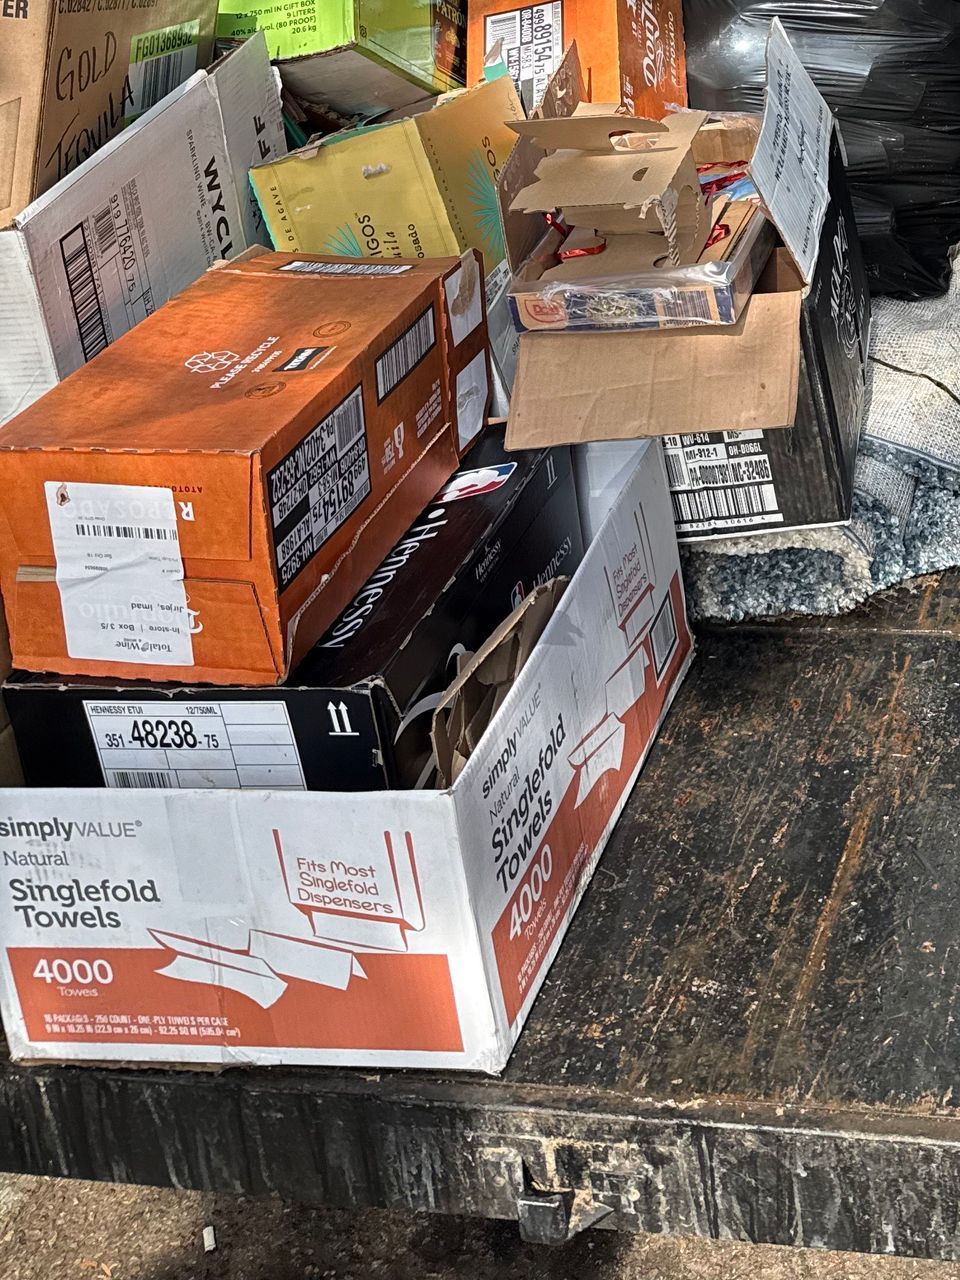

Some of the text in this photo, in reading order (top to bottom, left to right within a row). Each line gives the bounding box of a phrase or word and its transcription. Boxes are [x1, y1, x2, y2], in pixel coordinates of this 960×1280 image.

[284, 2, 299, 10] GIFT
[300, 0, 316, 8] BOX
[293, 8, 316, 17] LITERS
[289, 16, 316, 26] PROOF)
[308, 24, 317, 32] kg
[534, 8, 552, 75] 499 89154 75
[667, 10, 678, 87] REPOSADO
[56, 31, 117, 101] GOLD
[642, 24, 661, 93] Don
[45, 73, 135, 181] TEQUILA
[185, 129, 207, 209] SPARKLING WINE
[111, 194, 122, 220] 919
[269, 185, 295, 242] DE AGAVE
[115, 218, 136, 271] 776420
[357, 213, 383, 258] IGOS
[209, 362, 247, 389] PLEASE
[243, 336, 280, 364] RECYCLE
[324, 474, 355, 525] 89154
[312, 506, 324, 525] 75
[475, 539, 502, 579] Hennessy
[622, 542, 638, 568] Most
[318, 518, 448, 649] Hennessy
[616, 560, 642, 599] Singlefold
[131, 602, 153, 610] Imad
[617, 572, 648, 618] Dispensers
[118, 623, 135, 631] Box
[149, 626, 180, 634] In-store
[115, 639, 172, 652] Total Wine
[90, 705, 218, 715] HENNESSY ETUI 12/750ML
[105, 733, 126, 748] 351
[203, 734, 220, 748] 75
[488, 768, 520, 826] Natural
[491, 713, 567, 864] Singlefold
[495, 789, 553, 894] Towels
[3, 850, 70, 867] Natural
[296, 857, 376, 879] Fits Most
[9, 878, 161, 908] Singlefold
[299, 871, 380, 897] Singlefold
[509, 843, 553, 942] 4000
[297, 887, 394, 914] Dispensers
[14, 905, 122, 929] Towels
[524, 898, 547, 942] Towels
[32, 958, 114, 985] 4000
[56, 985, 99, 998] Towels
